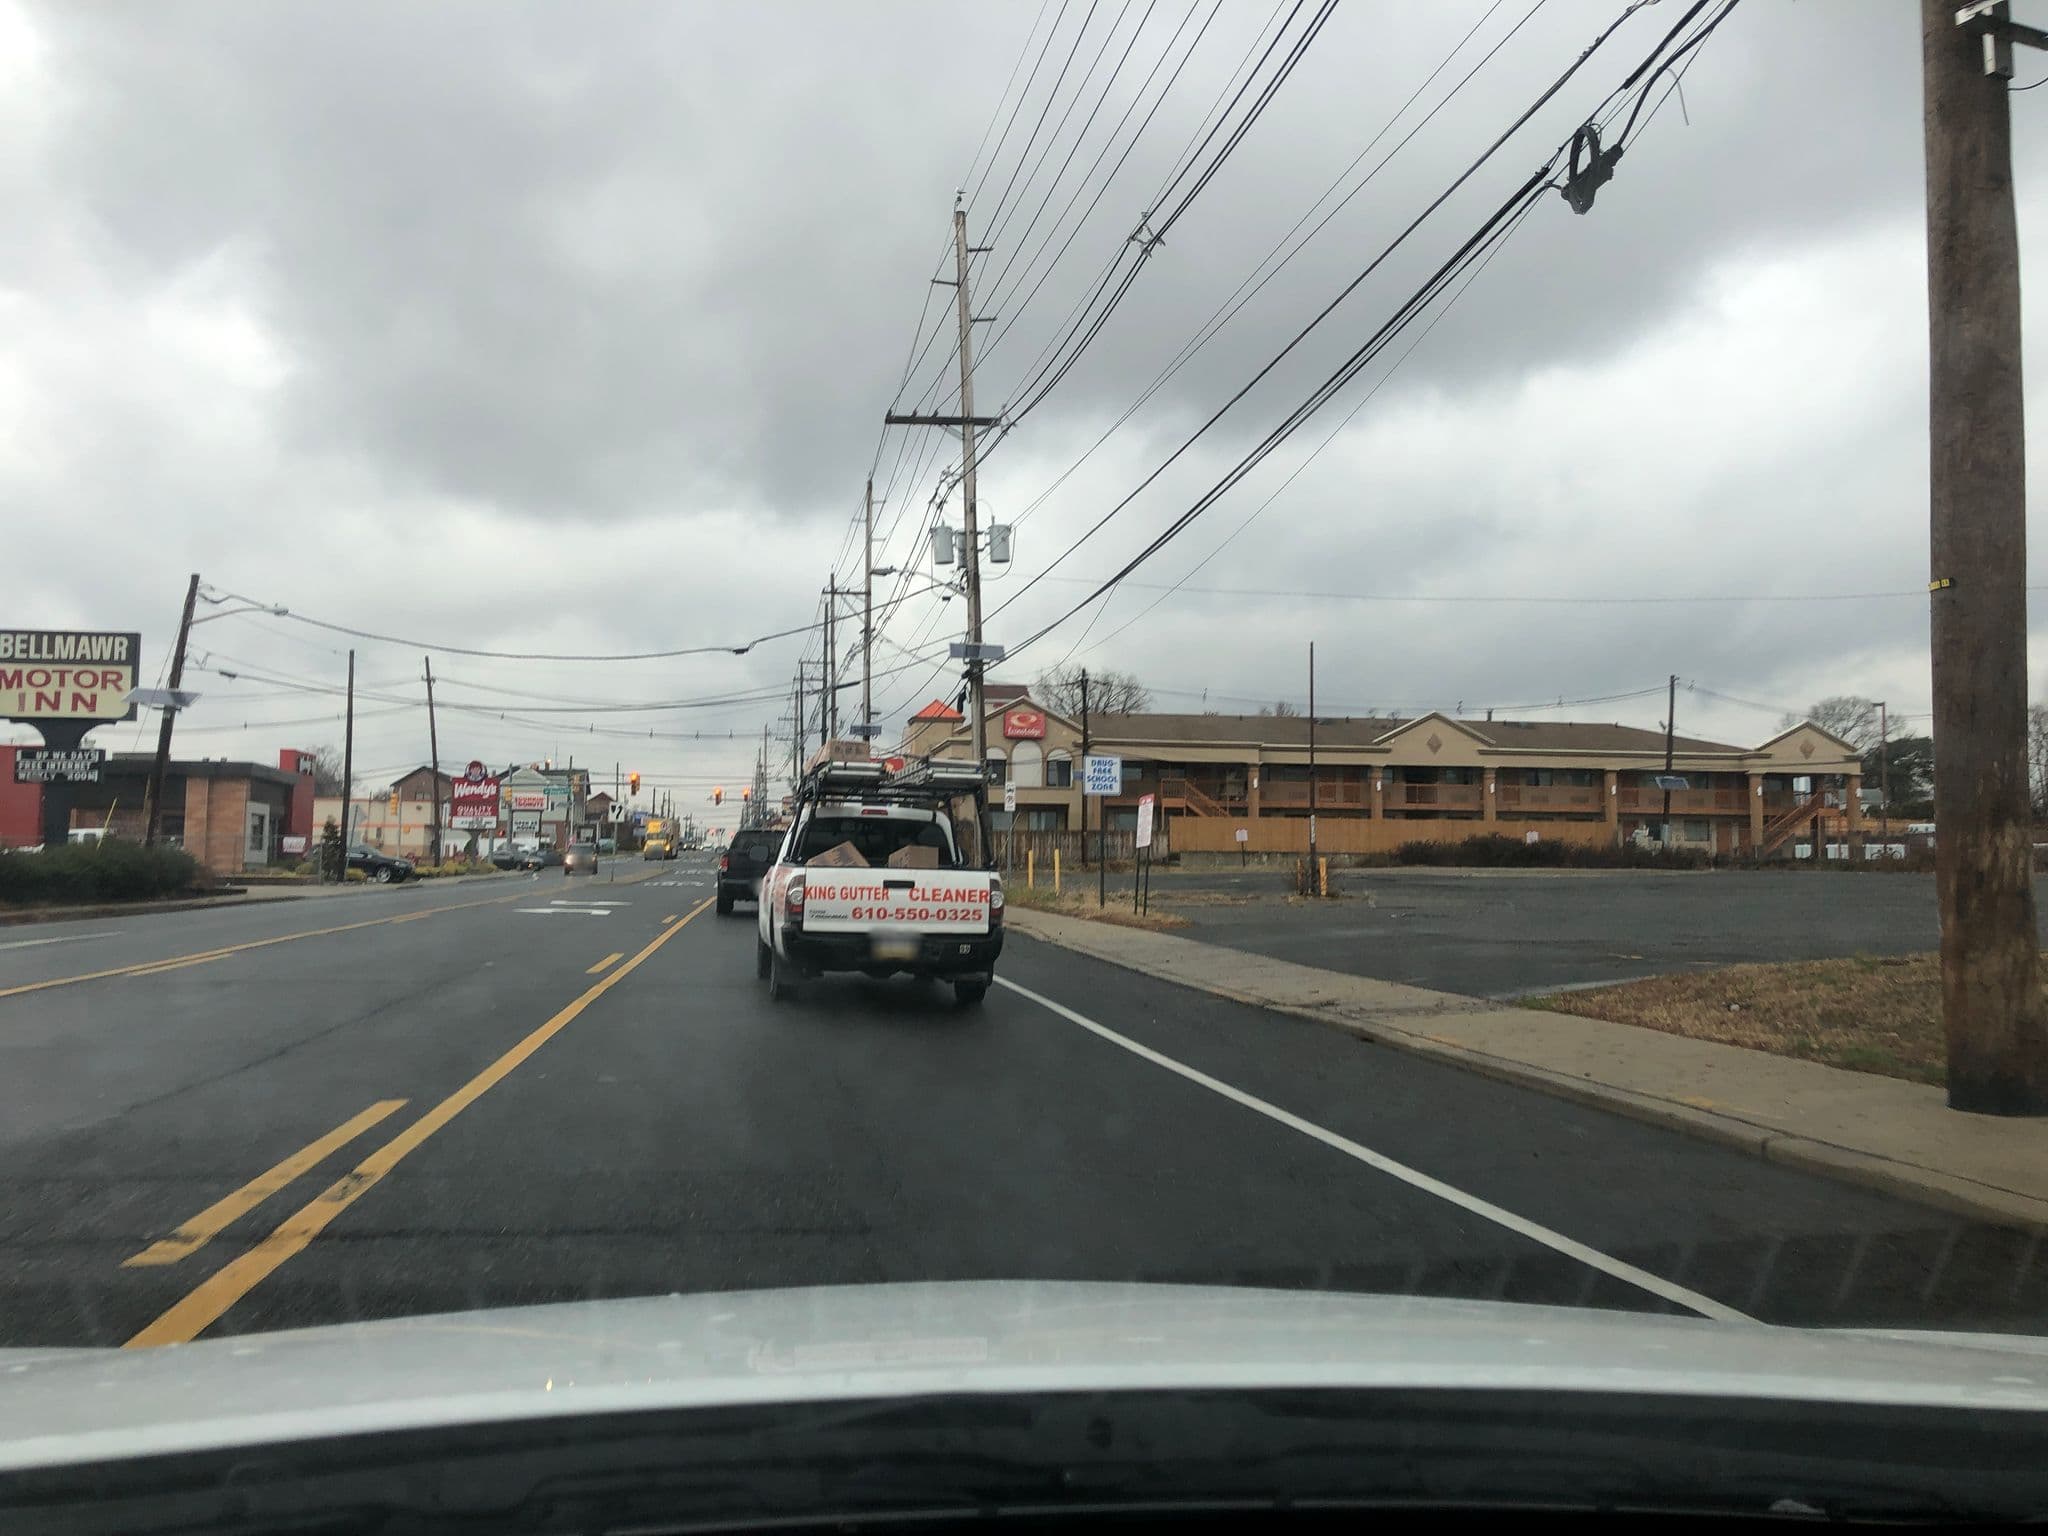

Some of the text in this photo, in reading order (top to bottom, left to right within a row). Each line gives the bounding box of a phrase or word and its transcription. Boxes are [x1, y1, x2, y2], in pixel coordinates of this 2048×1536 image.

[0, 633, 128, 661] BELLMAWR
[0, 670, 123, 692] MOTOR
[18, 691, 97, 712] INN
[36, 750, 49, 760] UP
[18, 761, 92, 771] FREE INTERNET
[1087, 775, 1117, 783] SCHOOL
[454, 779, 498, 799] Wendy's
[805, 886, 989, 904] KING GUTTER CLEANER
[852, 907, 983, 922] 610-550-0325
